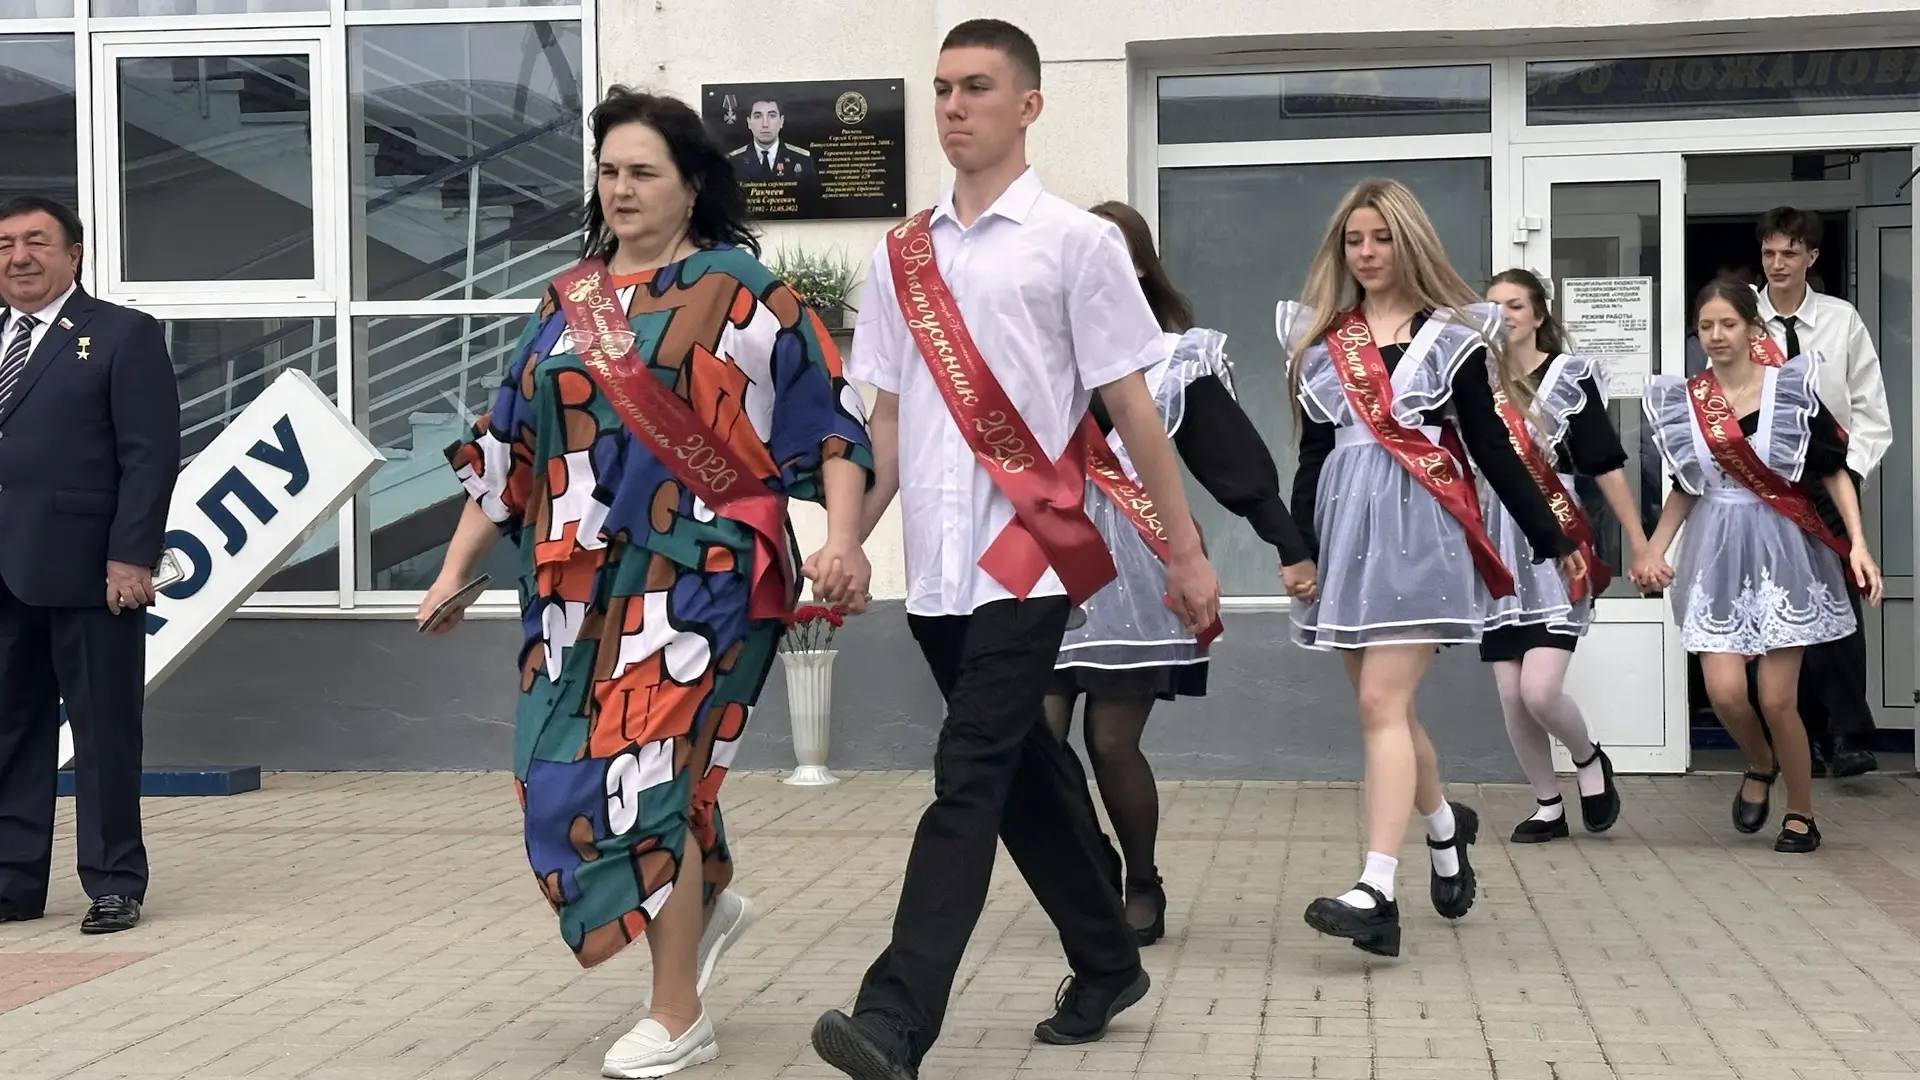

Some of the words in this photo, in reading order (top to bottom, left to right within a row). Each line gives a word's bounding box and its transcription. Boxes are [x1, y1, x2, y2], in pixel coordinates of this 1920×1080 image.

[900, 232, 979, 407] Выпускник
[971, 409, 1035, 474] 2026
[673, 433, 739, 494] 2026
[1414, 451, 1454, 487] 202
